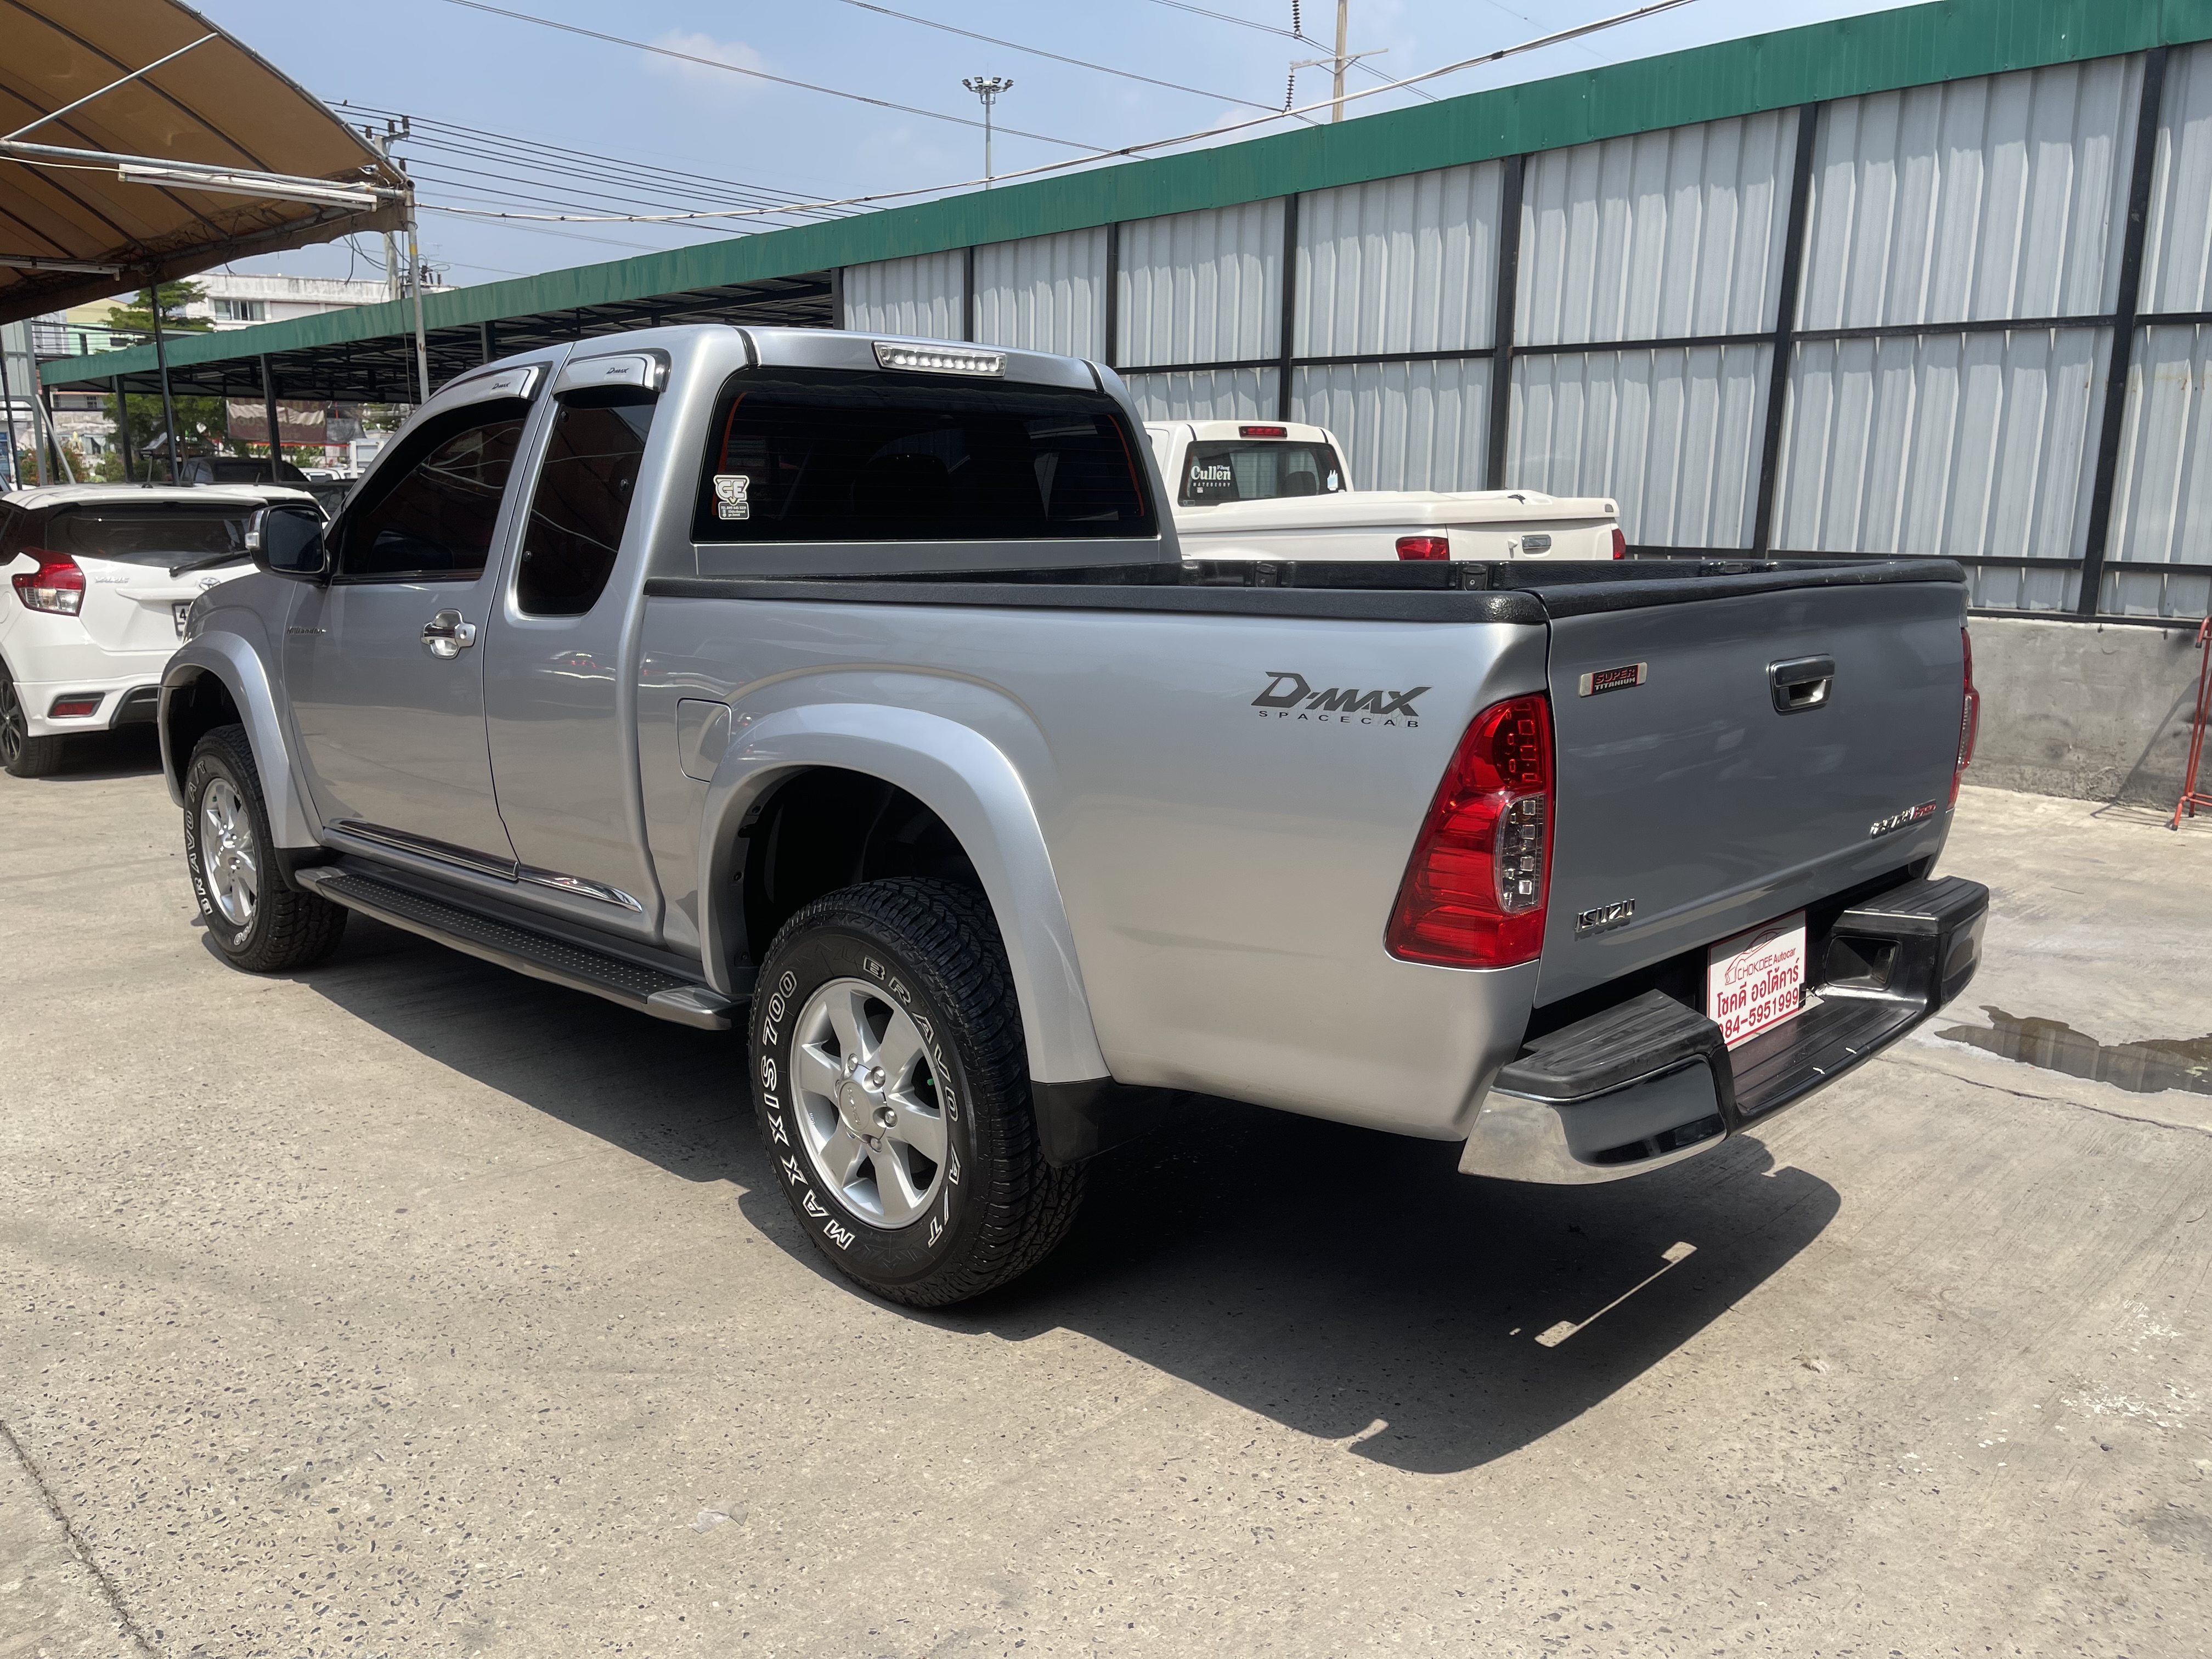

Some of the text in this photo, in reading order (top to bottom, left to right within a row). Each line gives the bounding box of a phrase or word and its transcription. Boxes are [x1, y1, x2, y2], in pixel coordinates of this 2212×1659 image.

[1190, 465, 1231, 480] Cullen
[718, 481, 744, 498] GE
[1594, 677, 1635, 691] TITANIUM
[1595, 669, 1635, 684] SUPER
[1251, 672, 1433, 716] D-MAX
[1259, 710, 1419, 728] SPACECAB
[185, 810, 213, 916] BRAVO
[1575, 899, 1635, 933] ISUZU
[1737, 947, 1796, 980] CHOKDEE Autocar
[1717, 957, 1800, 1018] โชคดี ออโต้คาร์
[760, 969, 855, 1251] MAXXIS 700
[863, 956, 960, 1249] BRAVO A/T
